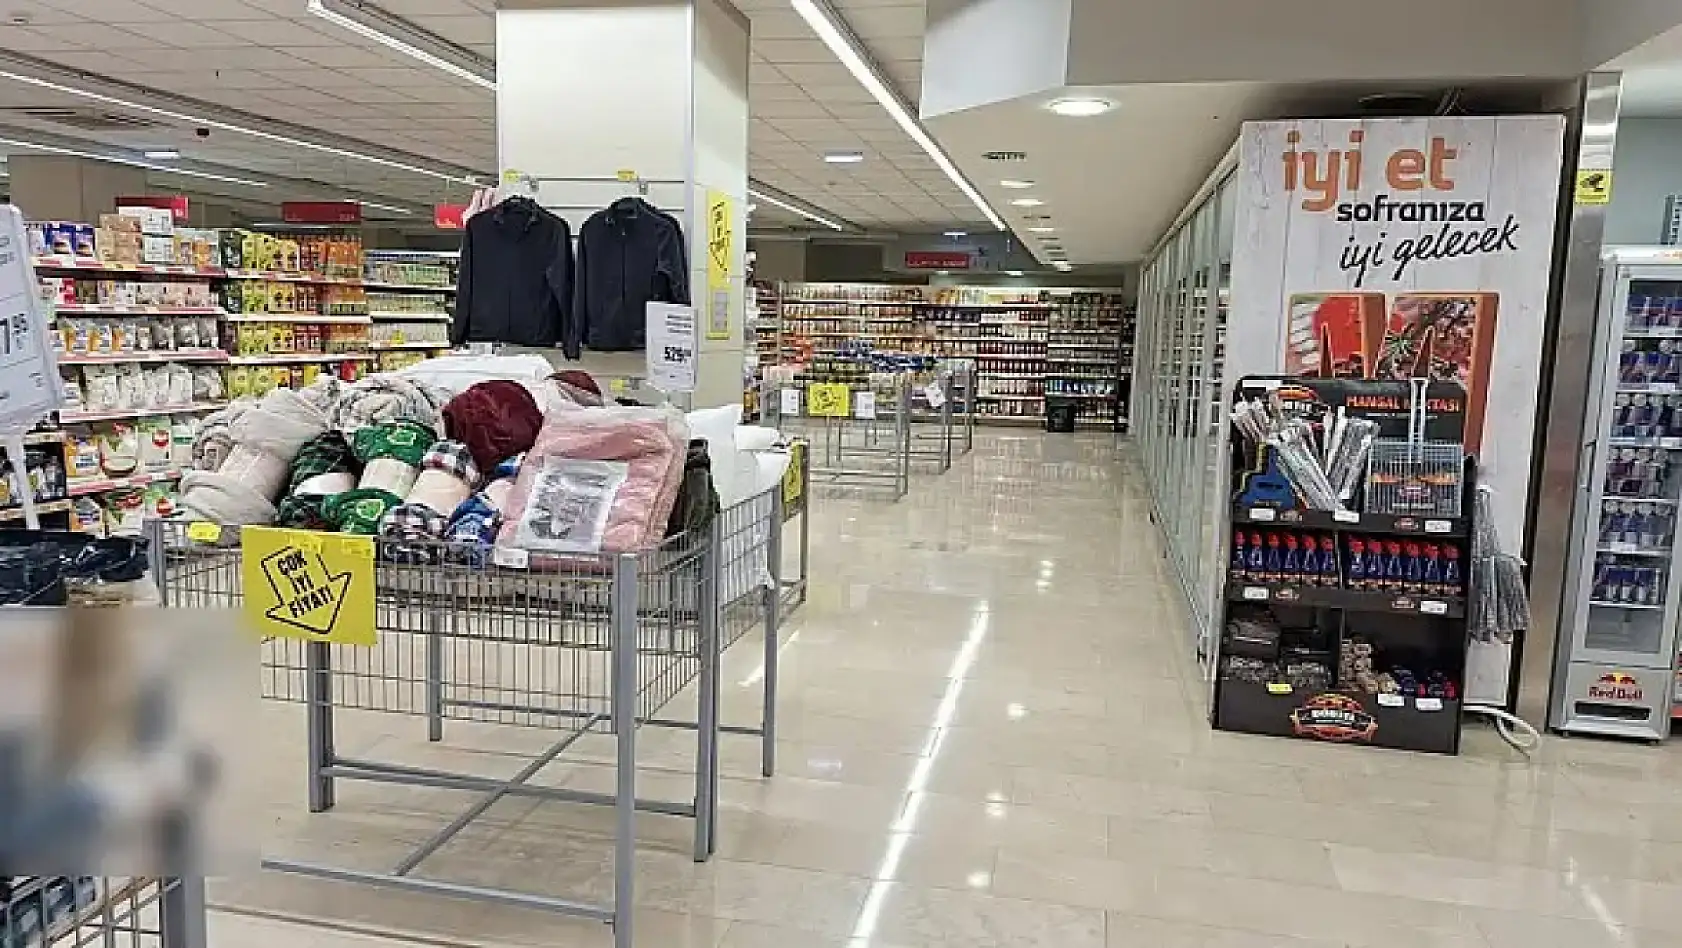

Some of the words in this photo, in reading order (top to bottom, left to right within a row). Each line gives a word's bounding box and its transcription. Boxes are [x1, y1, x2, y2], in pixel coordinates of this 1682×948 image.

[1282, 130, 1364, 211] iyi
[1386, 137, 1457, 190] et
[1336, 194, 1485, 222] sofranıza
[1339, 231, 1387, 287] iyi
[1392, 215, 1520, 281] gelecek
[277, 549, 308, 576] ÇOK
